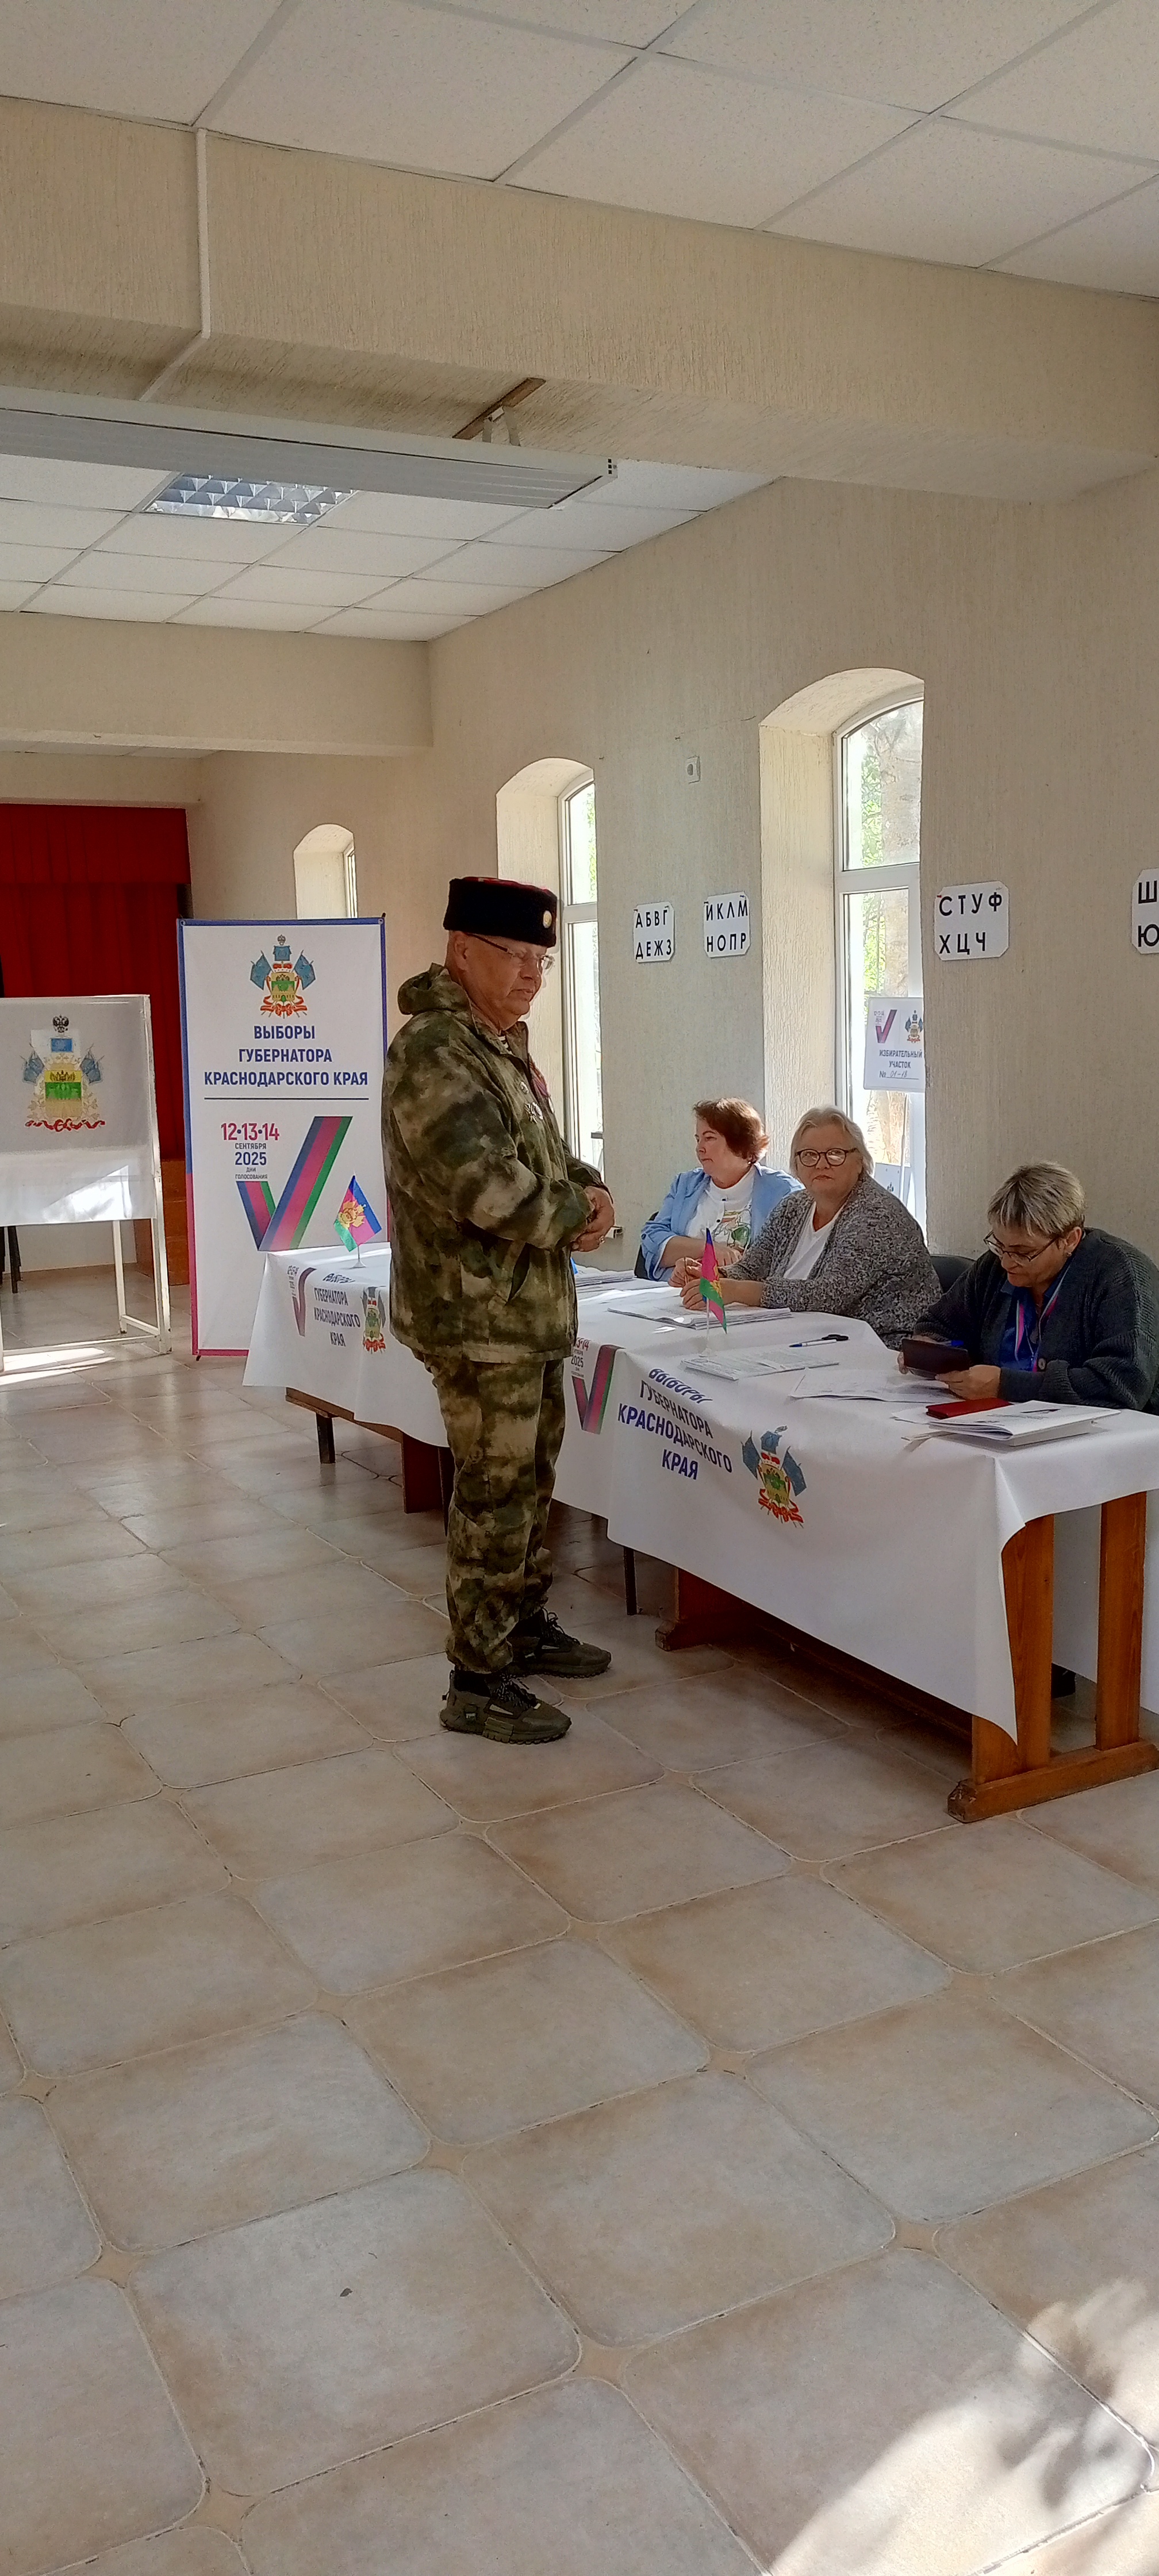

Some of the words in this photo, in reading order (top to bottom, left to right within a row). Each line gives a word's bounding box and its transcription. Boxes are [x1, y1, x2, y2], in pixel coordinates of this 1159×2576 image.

[1138, 880, 1157, 904] Ш
[254, 1025, 315, 1039] ВЫБОРЫ
[239, 1048, 332, 1062] ГУБЕРНАТОРА
[879, 1049, 922, 1058] ИЗБИРАТЕЛЬНЫЙ
[204, 1071, 329, 1087] КРАСНОДАРСКОГО
[333, 1072, 368, 1085] КРАЯ
[235, 1152, 267, 1166] 2025
[314, 1287, 348, 1306] ГУБЕРНАТОРА
[314, 1307, 360, 1328] КРАСНОДАРСКОГО
[329, 1332, 346, 1347] КРАЯ
[648, 1368, 713, 1404] ВЫБОРЫ
[640, 1379, 713, 1439] ГУБЕРНАТОРА
[618, 1402, 732, 1473] КРАСНОДАРСКОГО
[662, 1449, 699, 1480] КРАЯ
